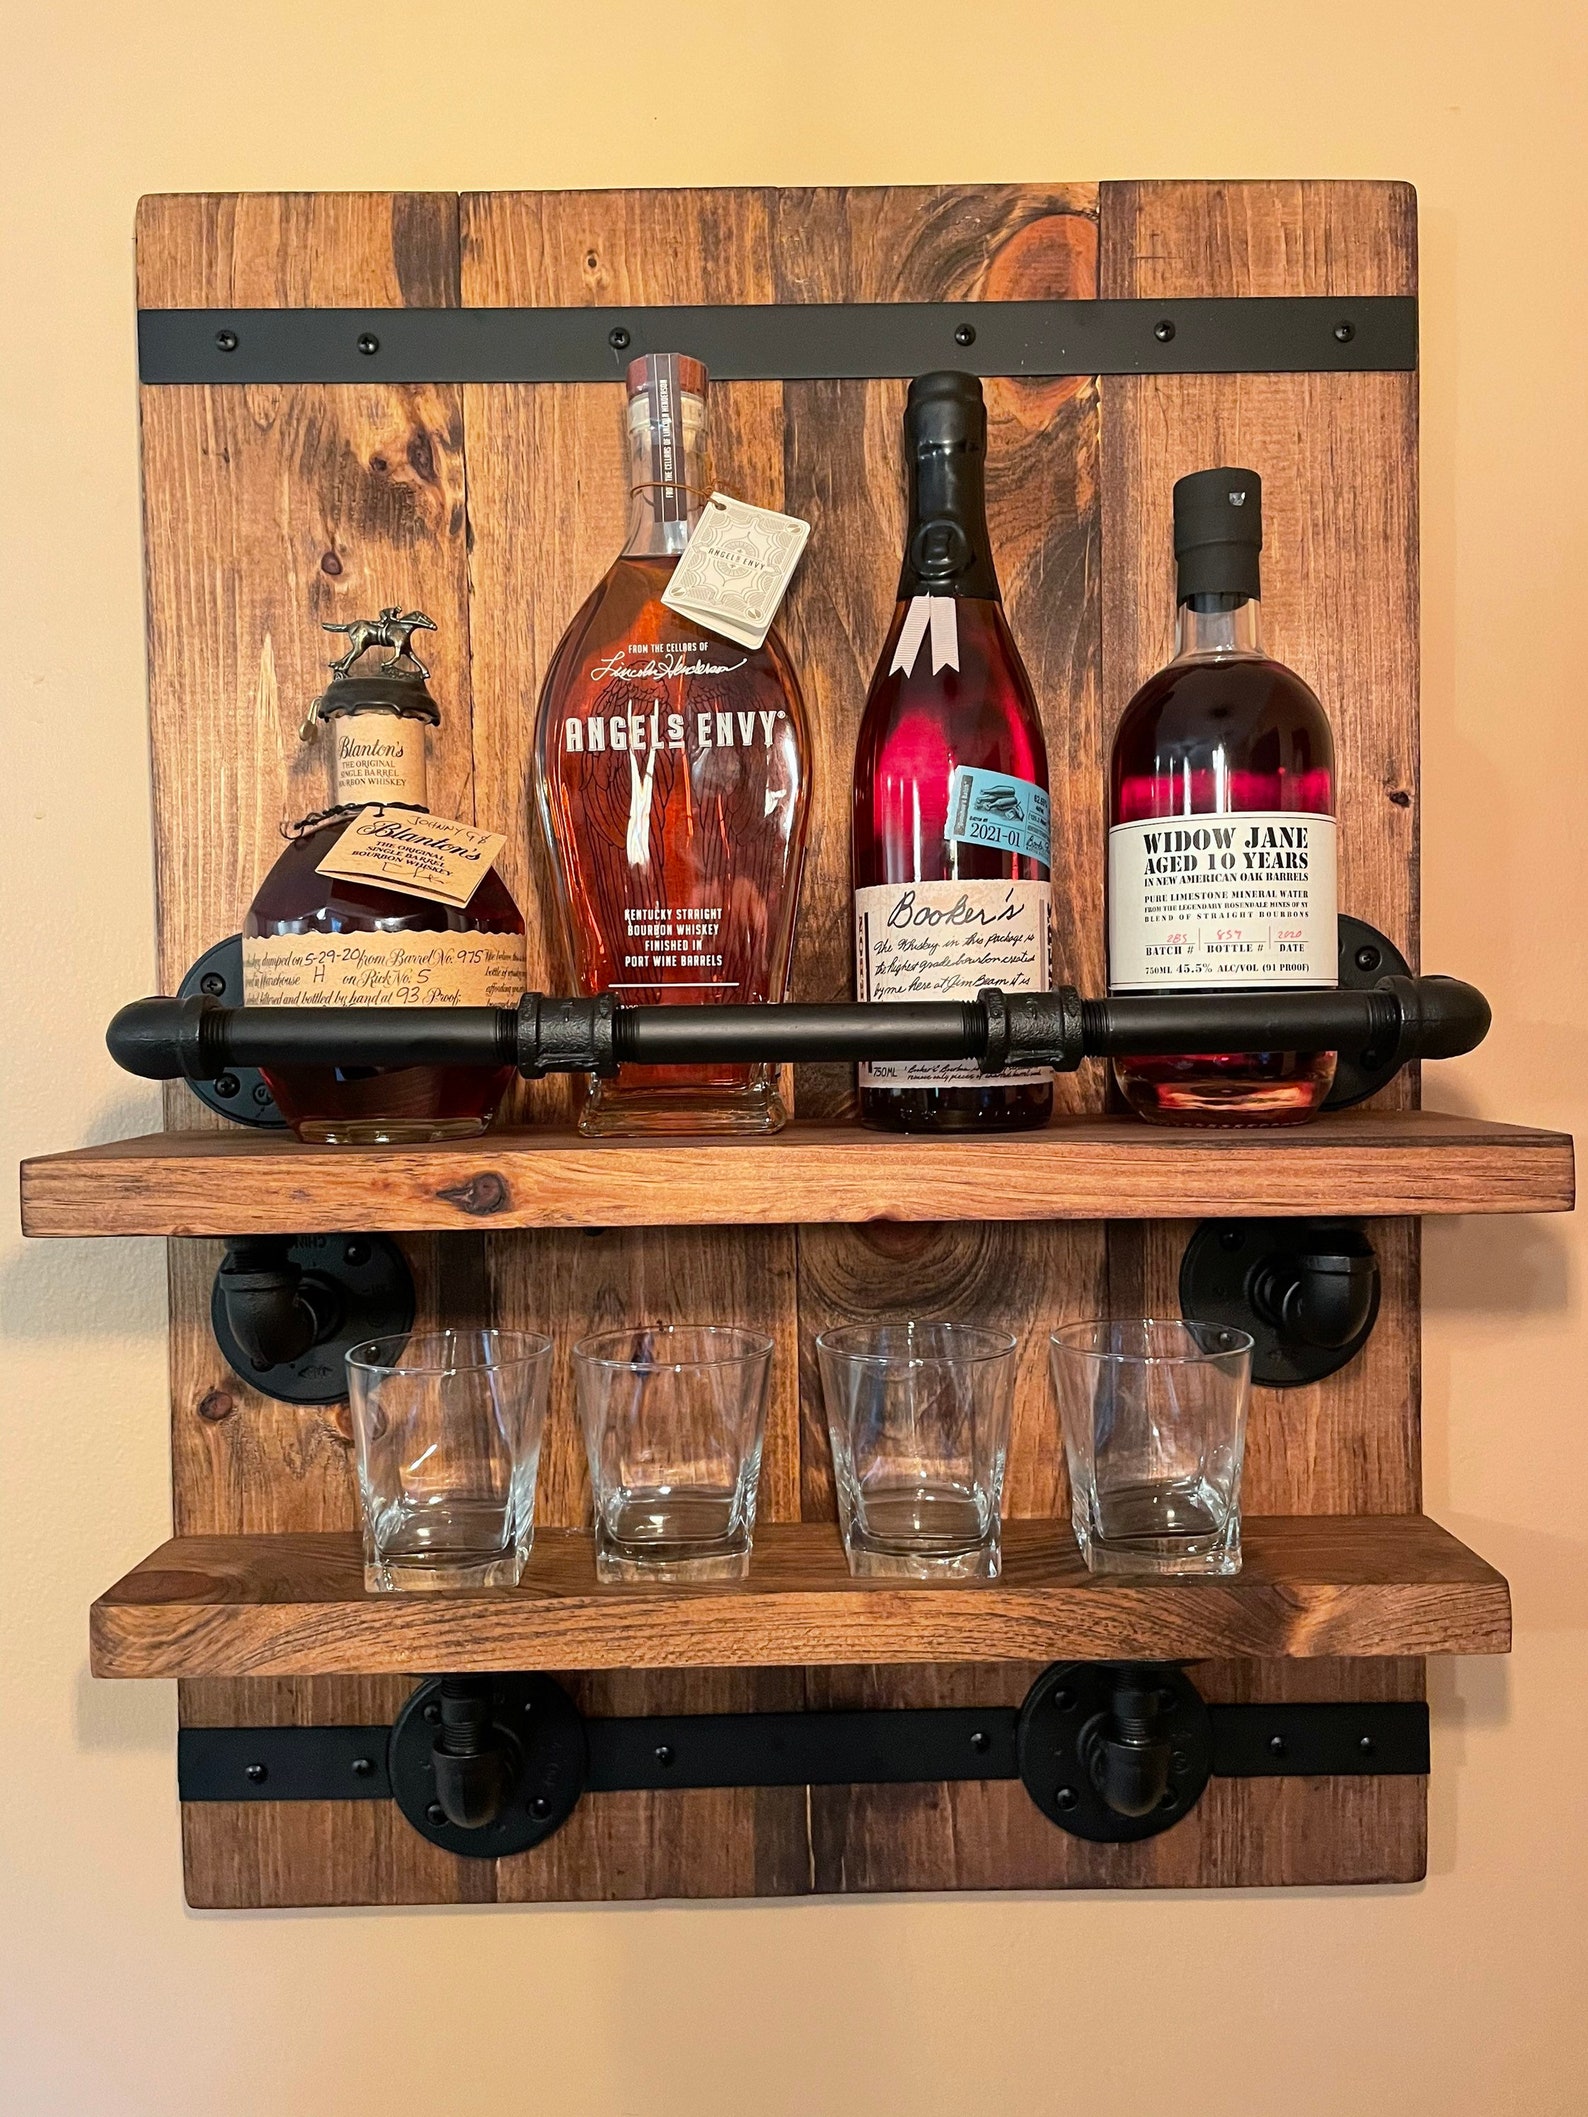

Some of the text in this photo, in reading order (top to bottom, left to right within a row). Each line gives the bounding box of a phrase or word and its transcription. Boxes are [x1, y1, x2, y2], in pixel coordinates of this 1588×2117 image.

[743, 558, 765, 570] ENVY
[628, 641, 708, 654] FROM THE CELLARS OF
[339, 736, 404, 759] Blanton's
[342, 760, 396, 769] THE ORIGINAL
[364, 769, 400, 777] BARREL
[367, 778, 407, 786] WHISKEY
[356, 820, 482, 861] Blanton's
[970, 822, 1021, 847] 2021-01
[1143, 827, 1308, 855] WIDOW JANE
[366, 846, 446, 868] SINGLE BARREL
[376, 841, 446, 860] THE ORIGINAL
[352, 850, 405, 863] BOURBON
[406, 859, 454, 877] WHISKEY
[1144, 851, 1309, 875] AGED 10 YEARS
[1144, 872, 1309, 887] IN NEW AMERICAN OAK BARRELS
[1144, 890, 1309, 903] PURE LIMESTONE MINERAL WATER
[887, 887, 1025, 929] Booker's
[1178, 903, 1223, 911] LEGENDARY
[1224, 901, 1268, 909] ROSENDALE
[624, 908, 723, 921] KENTUCKY STRAIGHT
[1144, 914, 1174, 923] BLEND
[1178, 913, 1192, 921] OF
[1196, 911, 1253, 920] STRAIGHT
[627, 924, 719, 936] BOURBON WHISKEY
[645, 939, 703, 951] FINISHED IN
[874, 931, 1036, 956] The Whiskey in this package is
[1207, 943, 1264, 953] BOTTLE #
[1279, 942, 1305, 952] DATE
[1145, 945, 1194, 956] BATCH #
[292, 956, 304, 967] on
[357, 949, 385, 969] from
[385, 948, 434, 967] Barrel
[456, 949, 484, 964] 975
[625, 954, 723, 967] PORT WINE BARRELS
[886, 956, 920, 977] highest
[919, 955, 953, 974] grade
[952, 952, 1001, 967] bourbon
[1001, 950, 1036, 965] created
[1145, 963, 1310, 975] 750ML 45.5% ALC/VOL (91 PROOF)
[312, 964, 326, 983] H
[342, 975, 357, 986] on
[356, 969, 391, 988] Rick
[416, 968, 432, 984] 5
[873, 982, 885, 999] by
[884, 986, 907, 995] me
[908, 976, 932, 992] here
[933, 976, 949, 989] at
[942, 974, 973, 994] Jim
[283, 991, 301, 1005] and
[300, 990, 334, 1005] bottled
[333, 990, 348, 1007] by
[348, 989, 382, 1007] hand
[381, 992, 394, 1005] at
[396, 986, 420, 1005] 93
[873, 1065, 898, 1078] 750ML
